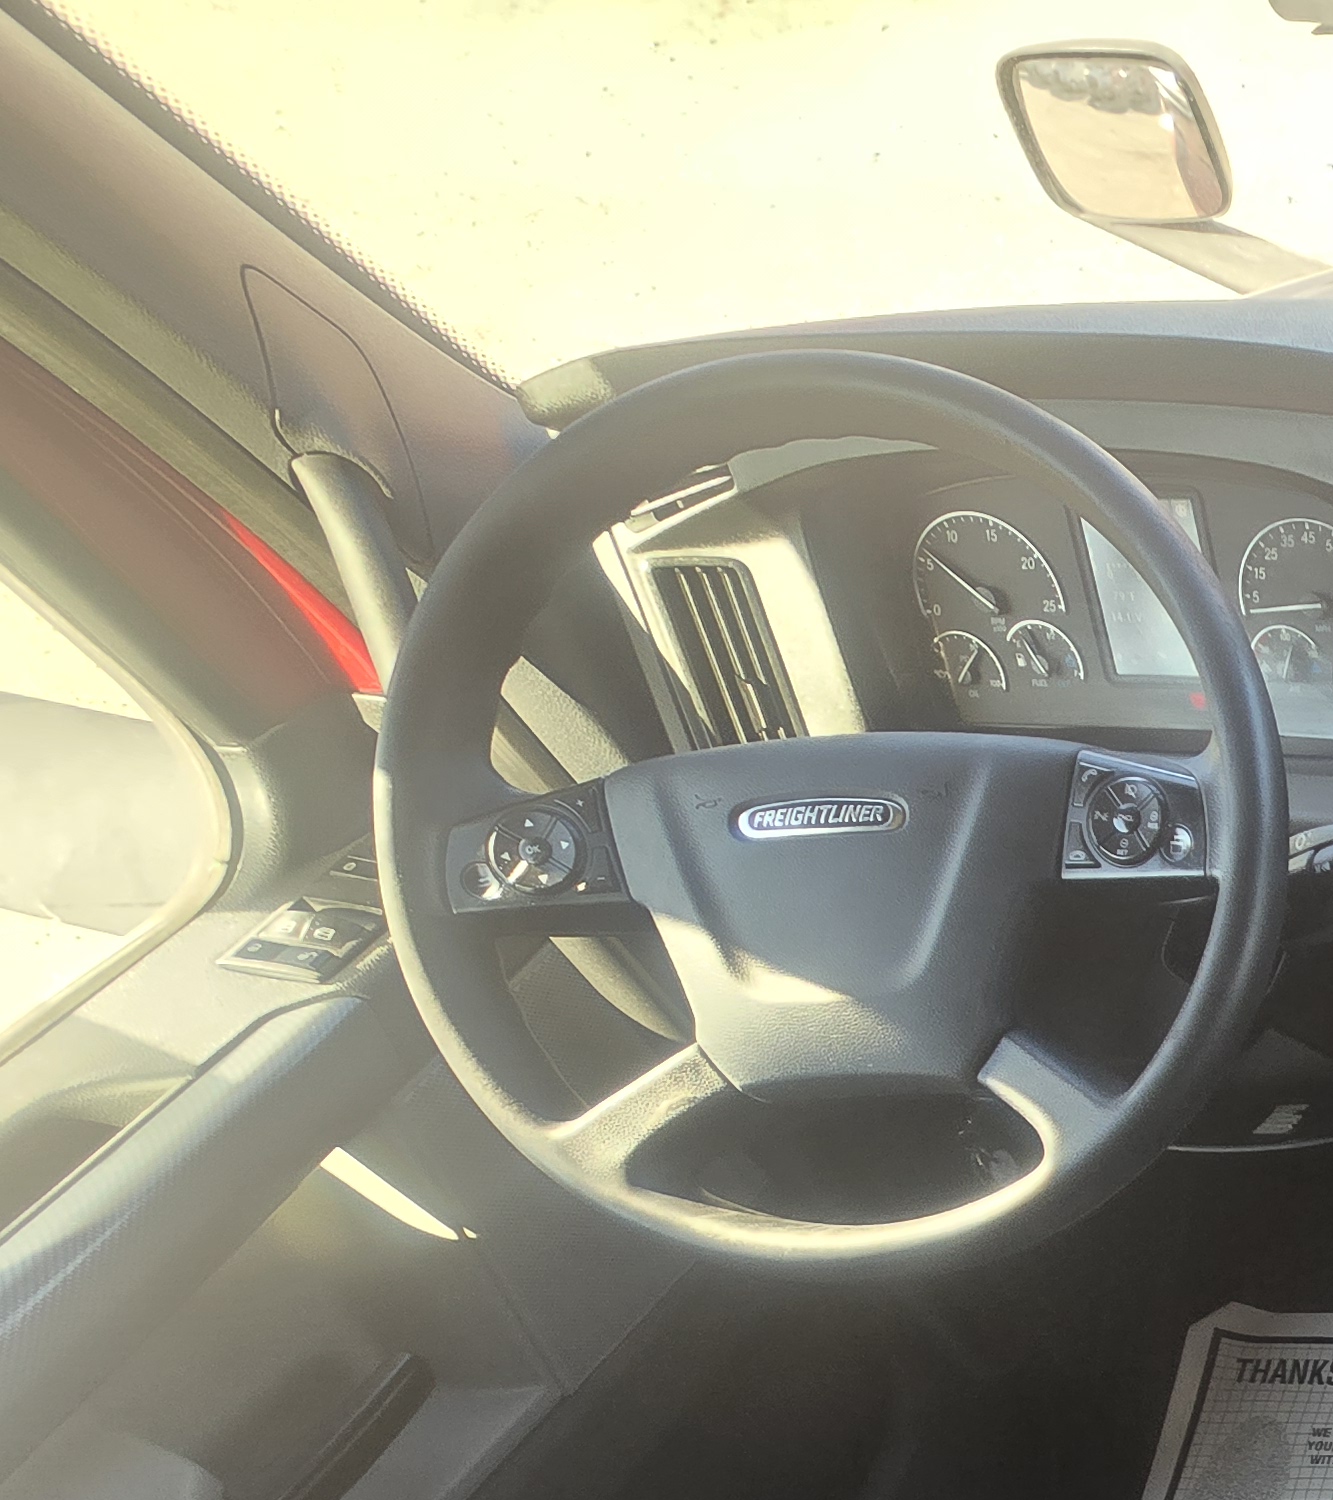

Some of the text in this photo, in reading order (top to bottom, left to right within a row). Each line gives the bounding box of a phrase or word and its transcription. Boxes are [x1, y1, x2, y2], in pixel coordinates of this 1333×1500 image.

[946, 531, 958, 543] 10
[986, 530, 998, 542] 15
[1280, 535, 1294, 548] 35
[1301, 532, 1316, 544] 45
[1264, 548, 1278, 561] 25
[926, 558, 934, 571] 5
[1021, 556, 1035, 570] 20
[1254, 567, 1266, 580] 15
[1252, 590, 1260, 603] 5
[933, 604, 941, 616] 0
[1043, 600, 1056, 613] 25
[753, 804, 884, 828] FREIGHTLINER
[1311, 1427, 1332, 1438] WE
